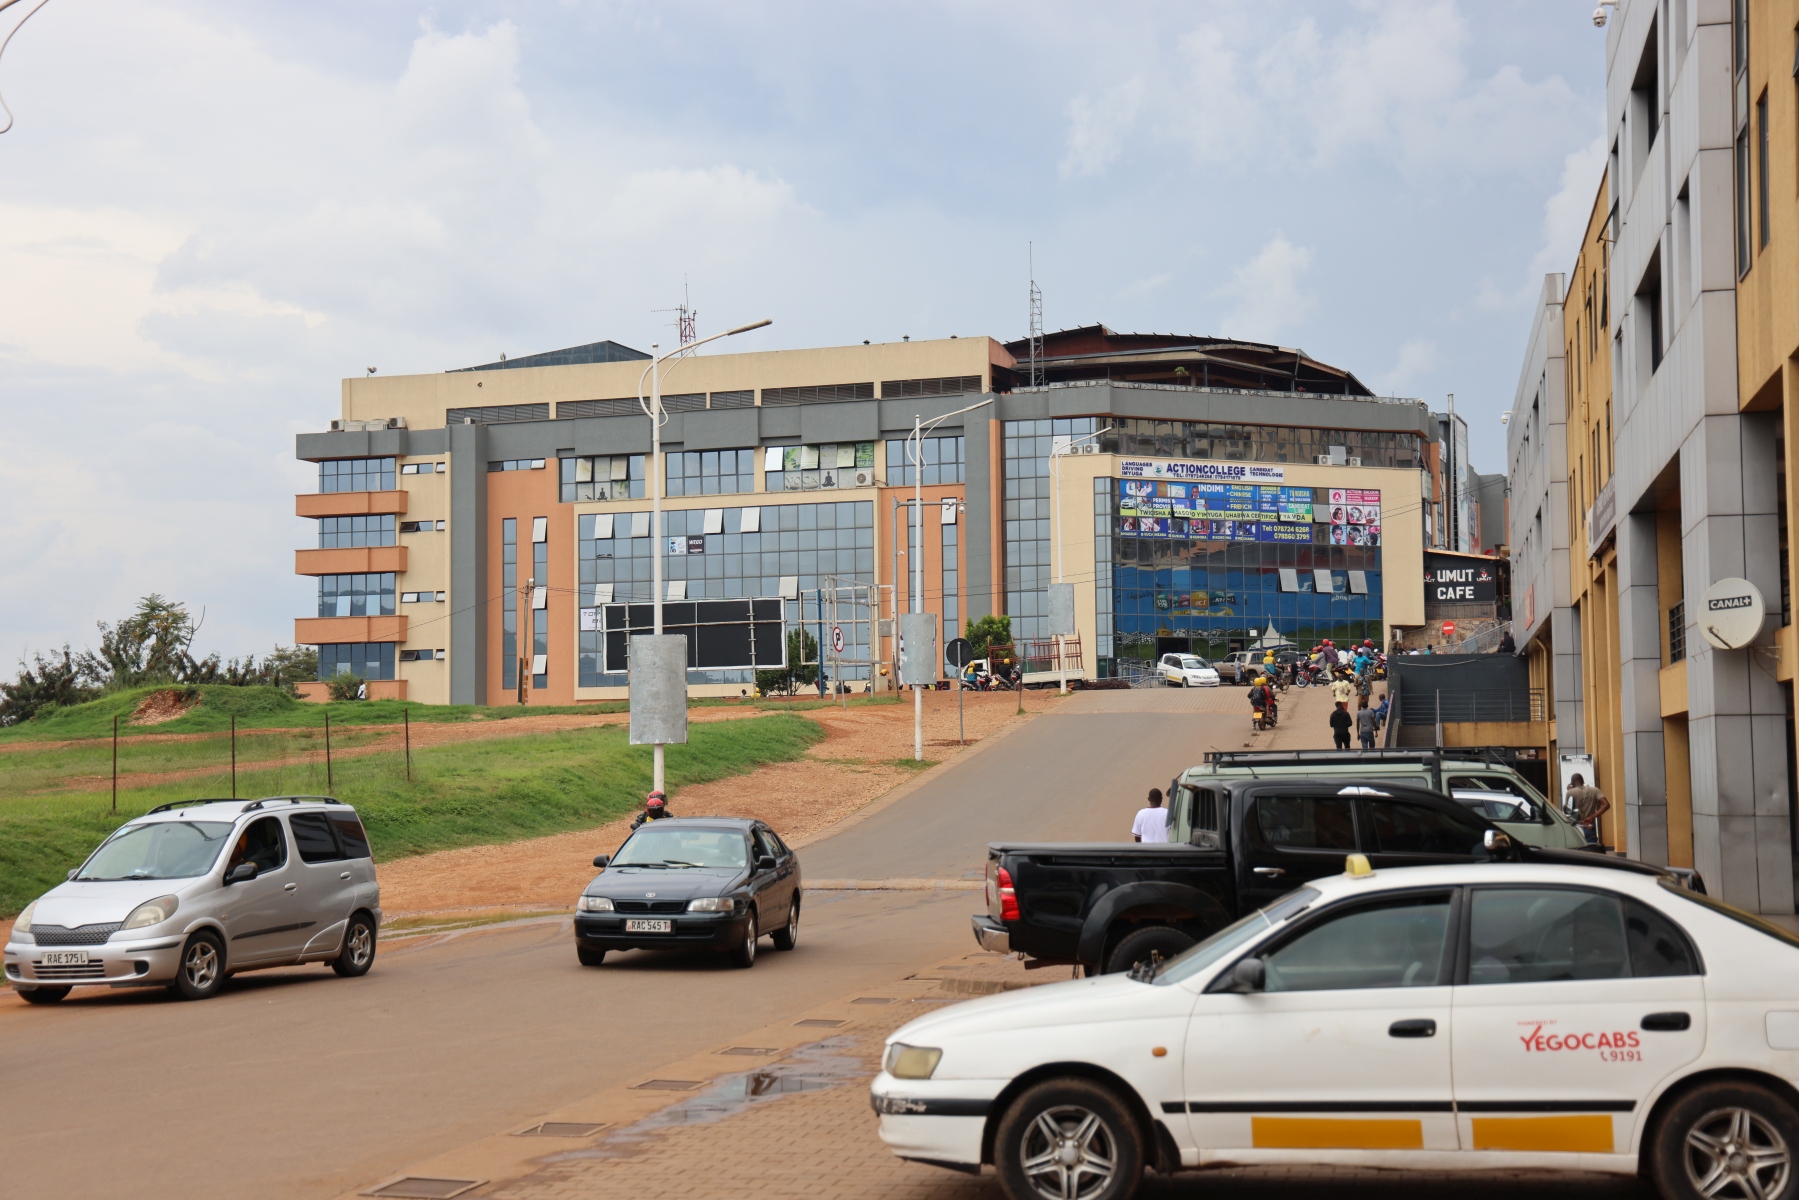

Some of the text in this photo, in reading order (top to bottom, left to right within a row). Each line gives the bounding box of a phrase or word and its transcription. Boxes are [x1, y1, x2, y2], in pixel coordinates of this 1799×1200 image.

[1166, 463, 1246, 476] ACTIONCOLLEGE
[1198, 484, 1224, 492] INDIMI
[1437, 569, 1474, 582] UMUT
[1437, 586, 1474, 599] CAFE
[1710, 597, 1751, 609] CANAL+
[1266, 830, 1290, 842] VAN
[631, 921, 668, 930] RAC 545 T
[47, 953, 86, 964] RAE 175 L
[1520, 1025, 1640, 1052] YEGOCABS
[1610, 1050, 1643, 1062] 9191
